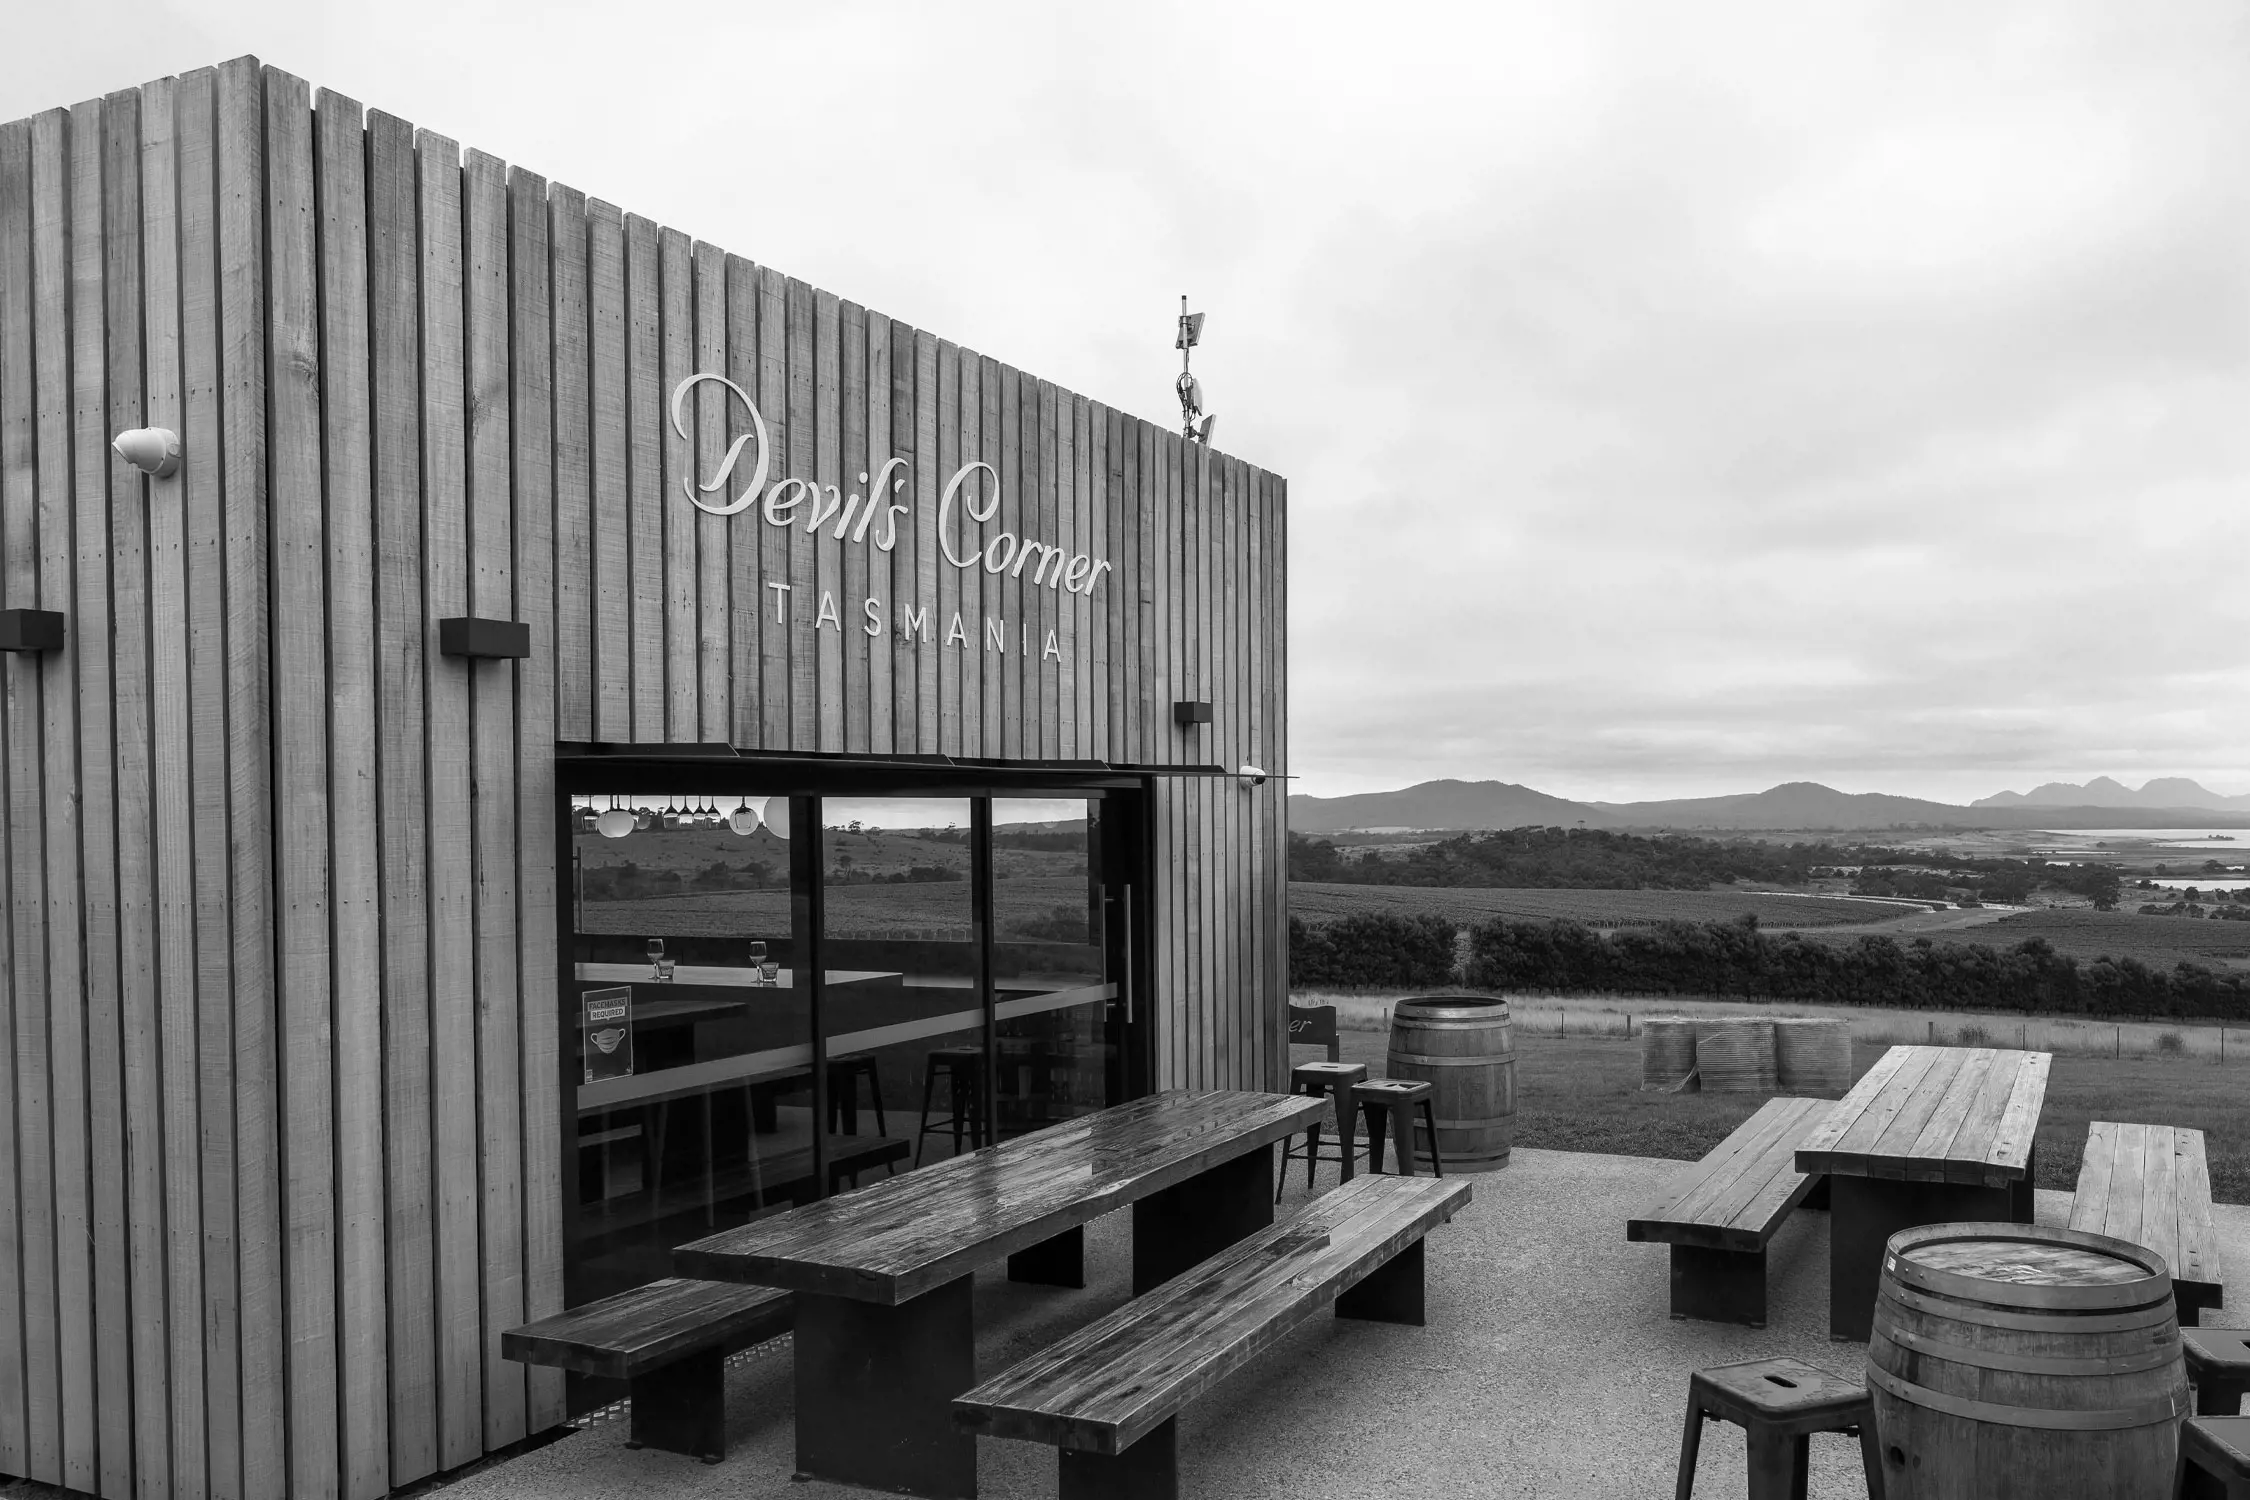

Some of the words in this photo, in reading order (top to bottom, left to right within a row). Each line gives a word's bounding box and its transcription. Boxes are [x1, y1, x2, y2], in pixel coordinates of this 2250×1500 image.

[672, 373, 909, 552] Devil's
[938, 461, 1112, 597] Corner
[768, 582, 1062, 663] TASMANIA
[589, 998, 626, 1010] FACEMASKS
[592, 1008, 624, 1019] REQUIRED
